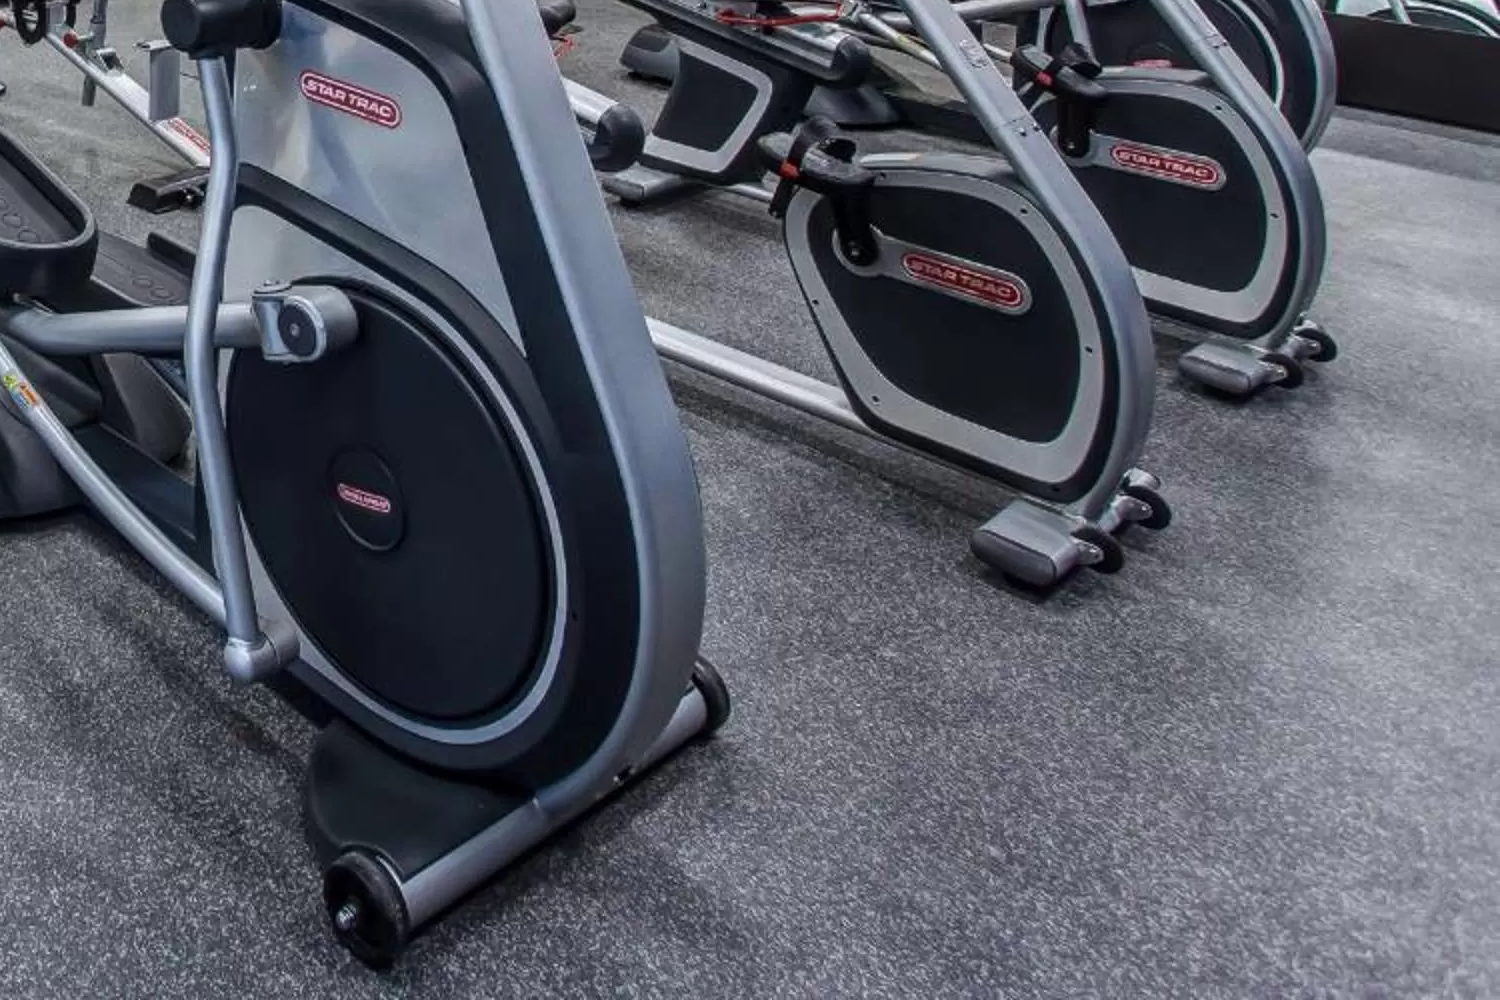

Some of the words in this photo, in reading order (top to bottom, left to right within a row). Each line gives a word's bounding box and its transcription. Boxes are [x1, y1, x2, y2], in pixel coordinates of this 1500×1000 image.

[306, 79, 347, 103] STAR
[347, 93, 395, 119] TRAC
[1118, 151, 1161, 168] STAR
[1163, 161, 1210, 178] TRAC
[909, 259, 958, 282] STAR
[959, 272, 1013, 298] TRAC
